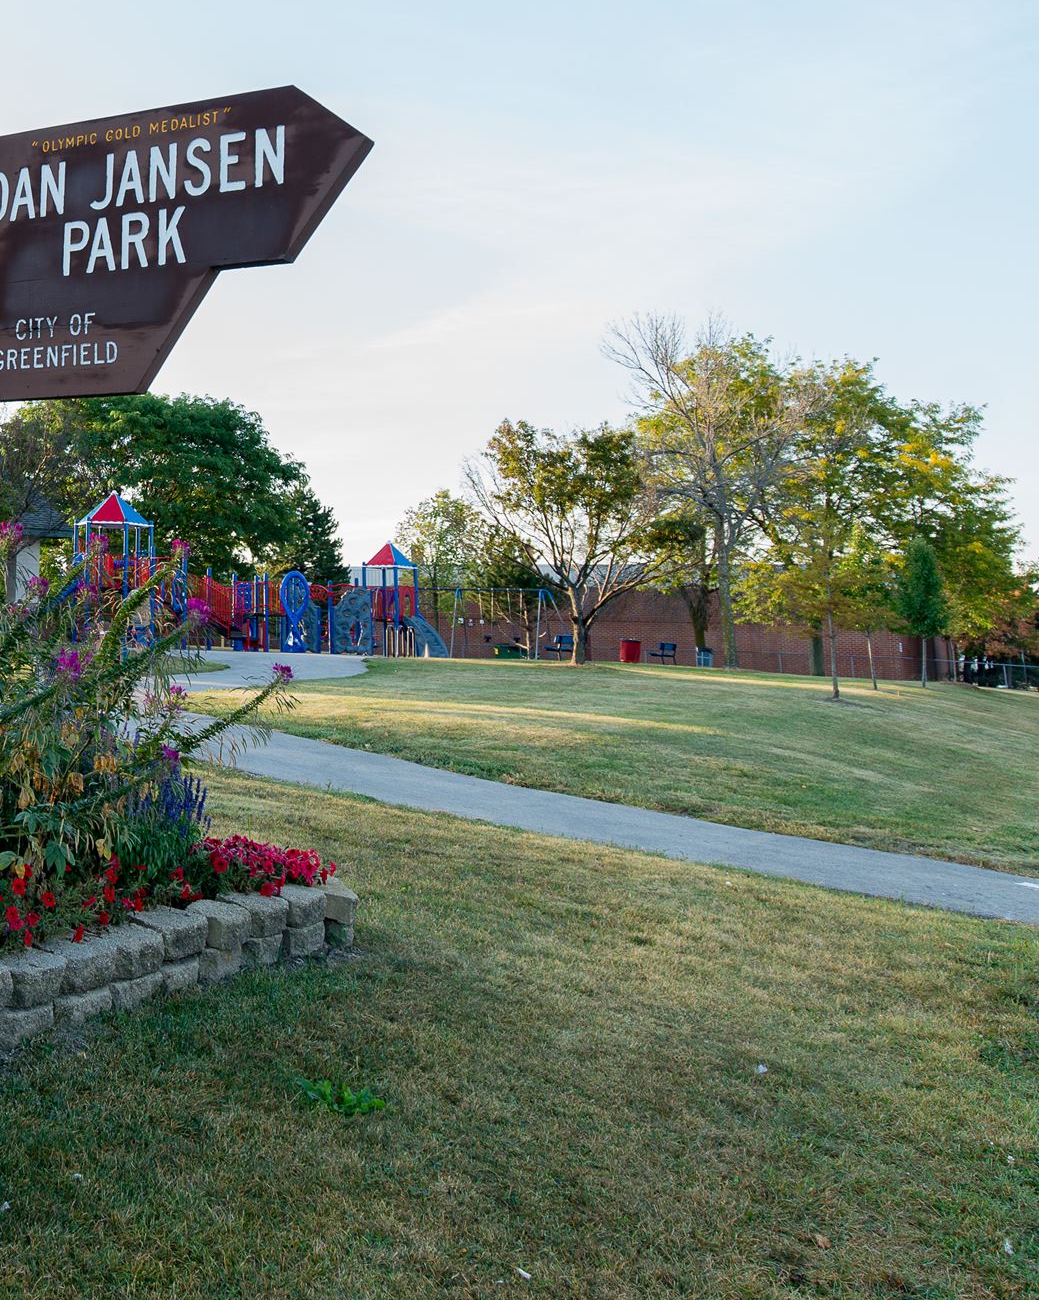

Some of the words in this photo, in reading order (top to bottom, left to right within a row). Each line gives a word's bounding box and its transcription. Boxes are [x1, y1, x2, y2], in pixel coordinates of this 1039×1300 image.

[105, 124, 141, 143] GOLD
[89, 124, 286, 211] JANSEN
[62, 205, 188, 277] PARK
[15, 316, 59, 342] CITY
[69, 312, 96, 337] OF
